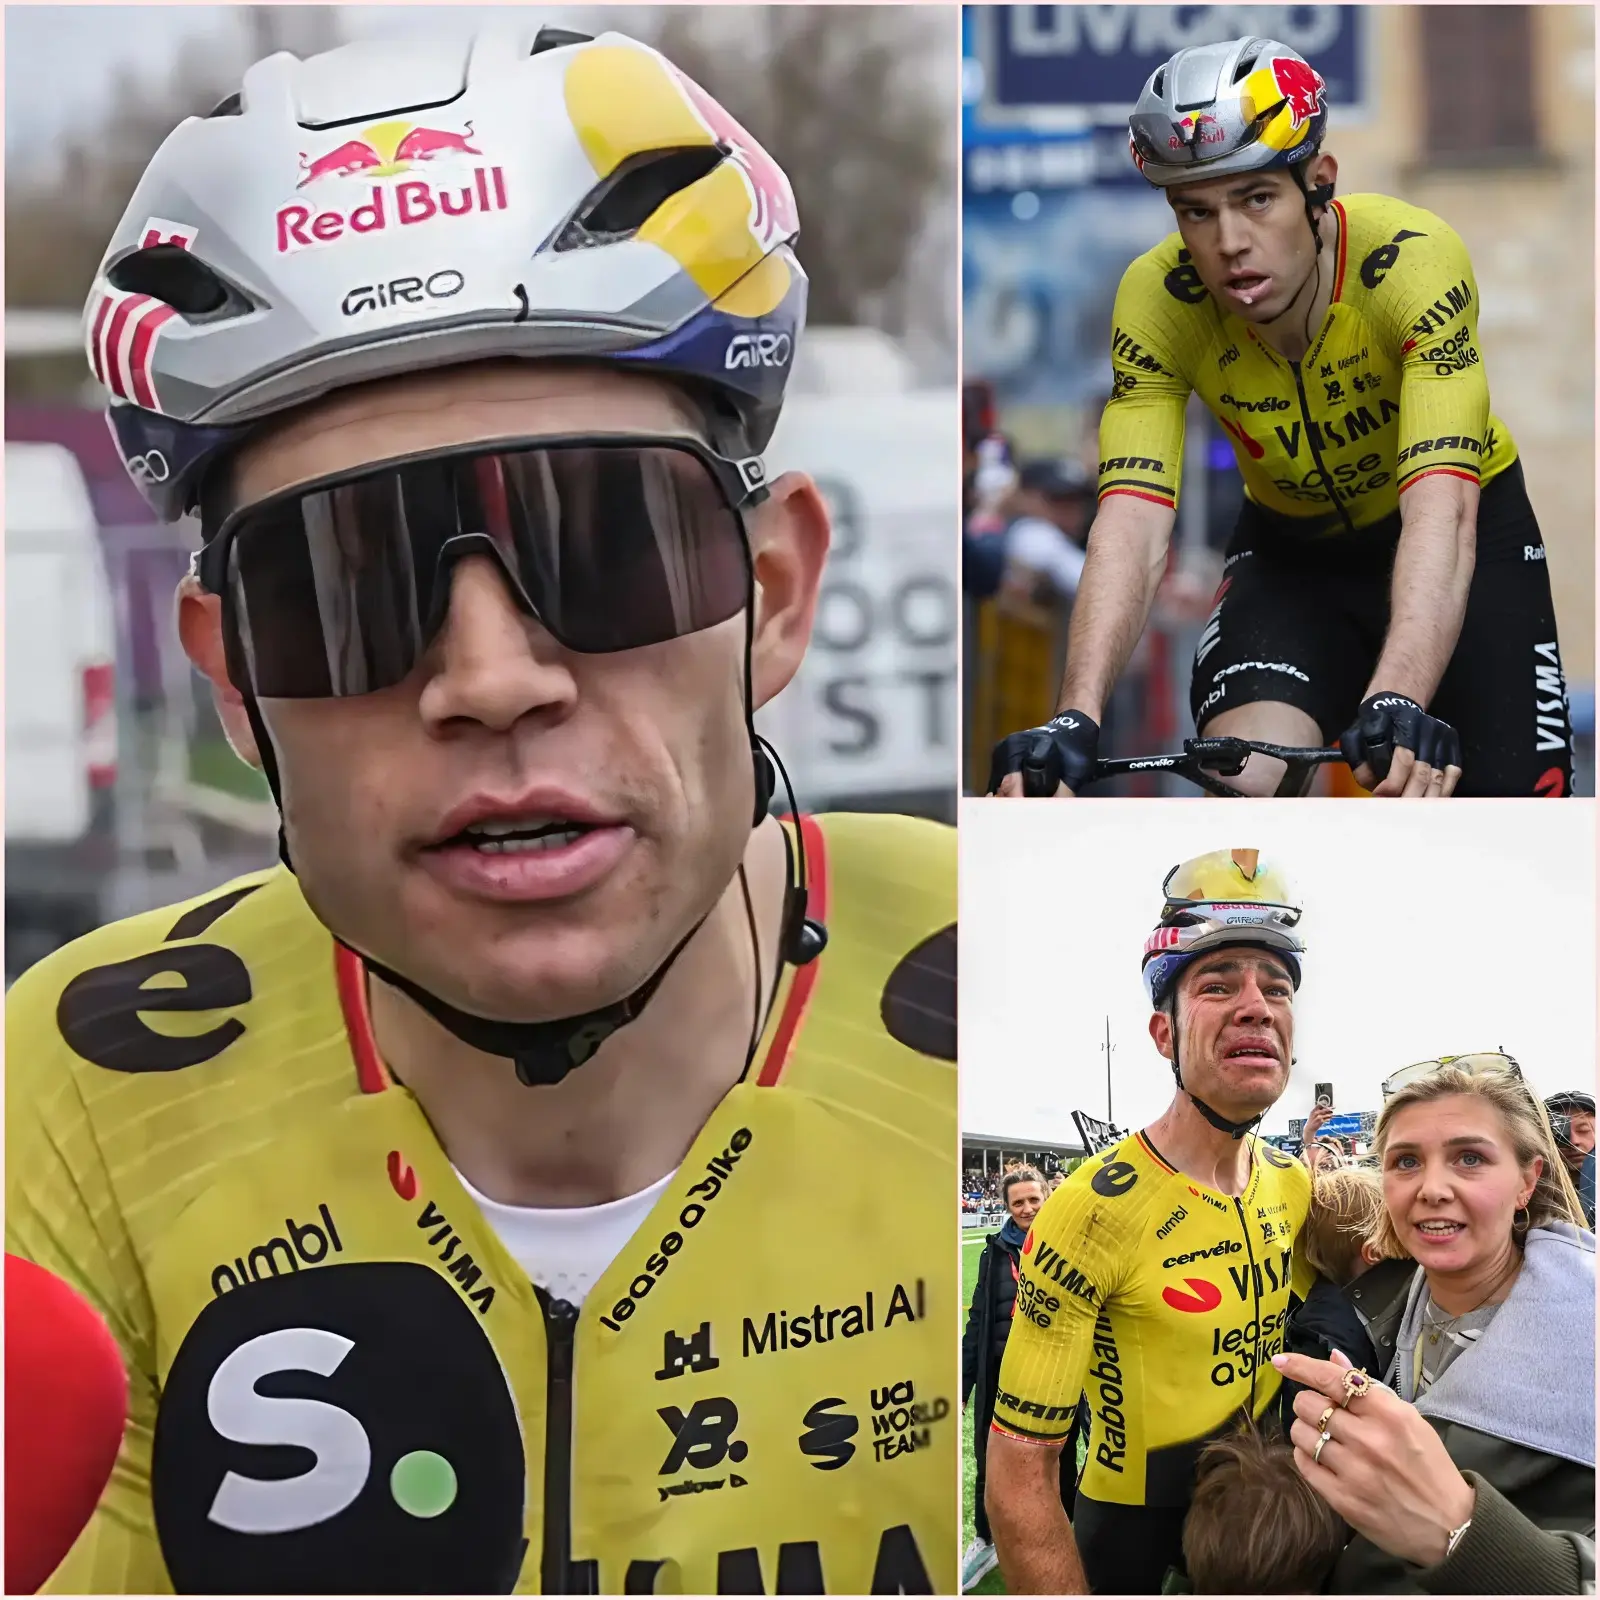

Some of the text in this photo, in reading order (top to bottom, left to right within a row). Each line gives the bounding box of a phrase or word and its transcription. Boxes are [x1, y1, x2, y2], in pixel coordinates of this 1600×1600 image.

[276, 166, 507, 253] Red Bull
[341, 268, 465, 317] GIRO
[1412, 280, 1472, 335] VISMA
[724, 332, 792, 371] GIRO
[1420, 326, 1470, 362] lease
[1274, 398, 1400, 459] VISMA
[1534, 641, 1566, 751] VISMA
[1156, 1204, 1189, 1240] nimbl
[1202, 1193, 1228, 1213] VISMA
[211, 1203, 344, 1297] nimbl
[417, 1201, 497, 1314] VISMA
[1033, 1240, 1097, 1301] VISMA
[1162, 1239, 1243, 1268] cervélo
[600, 1231, 684, 1333] lease
[1019, 1271, 1060, 1312] ease
[742, 1278, 926, 1358] Mistral AI
[1212, 1308, 1286, 1356] lease
